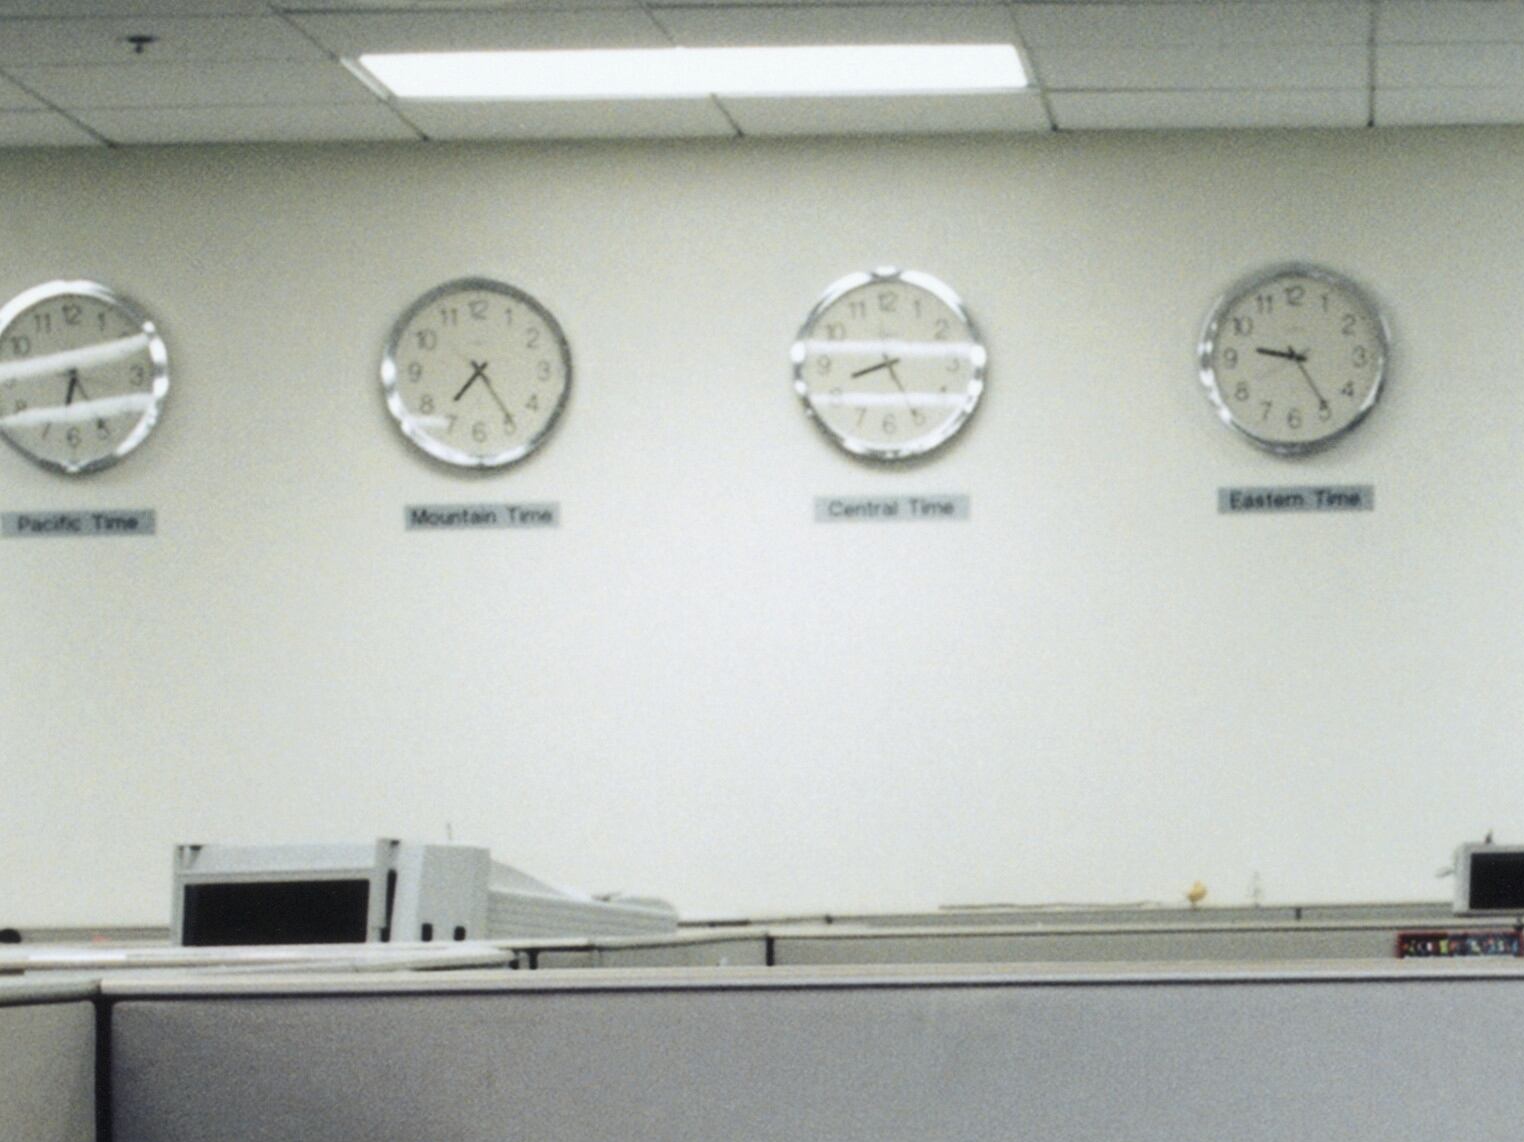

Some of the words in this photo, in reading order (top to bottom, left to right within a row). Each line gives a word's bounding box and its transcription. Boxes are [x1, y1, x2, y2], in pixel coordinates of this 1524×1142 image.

[878, 291, 899, 312] 12
[1257, 294, 1273, 313] 11
[1285, 286, 1304, 306] 12
[1320, 294, 1328, 312] 1
[62, 304, 82, 325] 12
[440, 307, 458, 327] 11
[470, 300, 488, 320] 12
[505, 307, 513, 326] 1
[850, 301, 866, 319] 11
[914, 300, 922, 318] 1
[34, 313, 50, 333] 11
[98, 313, 106, 331] 1
[825, 322, 845, 341] 10
[935, 318, 949, 339] 2
[1232, 316, 1253, 337] 10
[1342, 313, 1356, 336] 2
[11, 334, 30, 355] 10
[416, 329, 437, 350] 10
[527, 328, 541, 348] 2
[817, 355, 831, 375] 9
[1223, 348, 1238, 369] 9
[1353, 345, 1367, 368] 3
[130, 364, 145, 386] 3
[408, 361, 422, 383] 9
[538, 360, 550, 381] 3
[1234, 381, 1249, 401] 8
[1341, 380, 1354, 397] 4
[419, 394, 434, 415] 8
[525, 394, 538, 411] 4
[1260, 401, 1272, 421] 7
[882, 413, 897, 435] 6
[1287, 408, 1302, 430] 6
[67, 428, 82, 449] 6
[472, 421, 487, 443] 6
[828, 499, 899, 517] Central
[909, 497, 955, 515] Time
[1229, 489, 1304, 510] Eastern
[1313, 488, 1362, 508] Time
[17, 514, 81, 532] Pacific
[91, 513, 139, 531] Time
[411, 507, 497, 525] Mountain
[507, 505, 553, 523] Time
